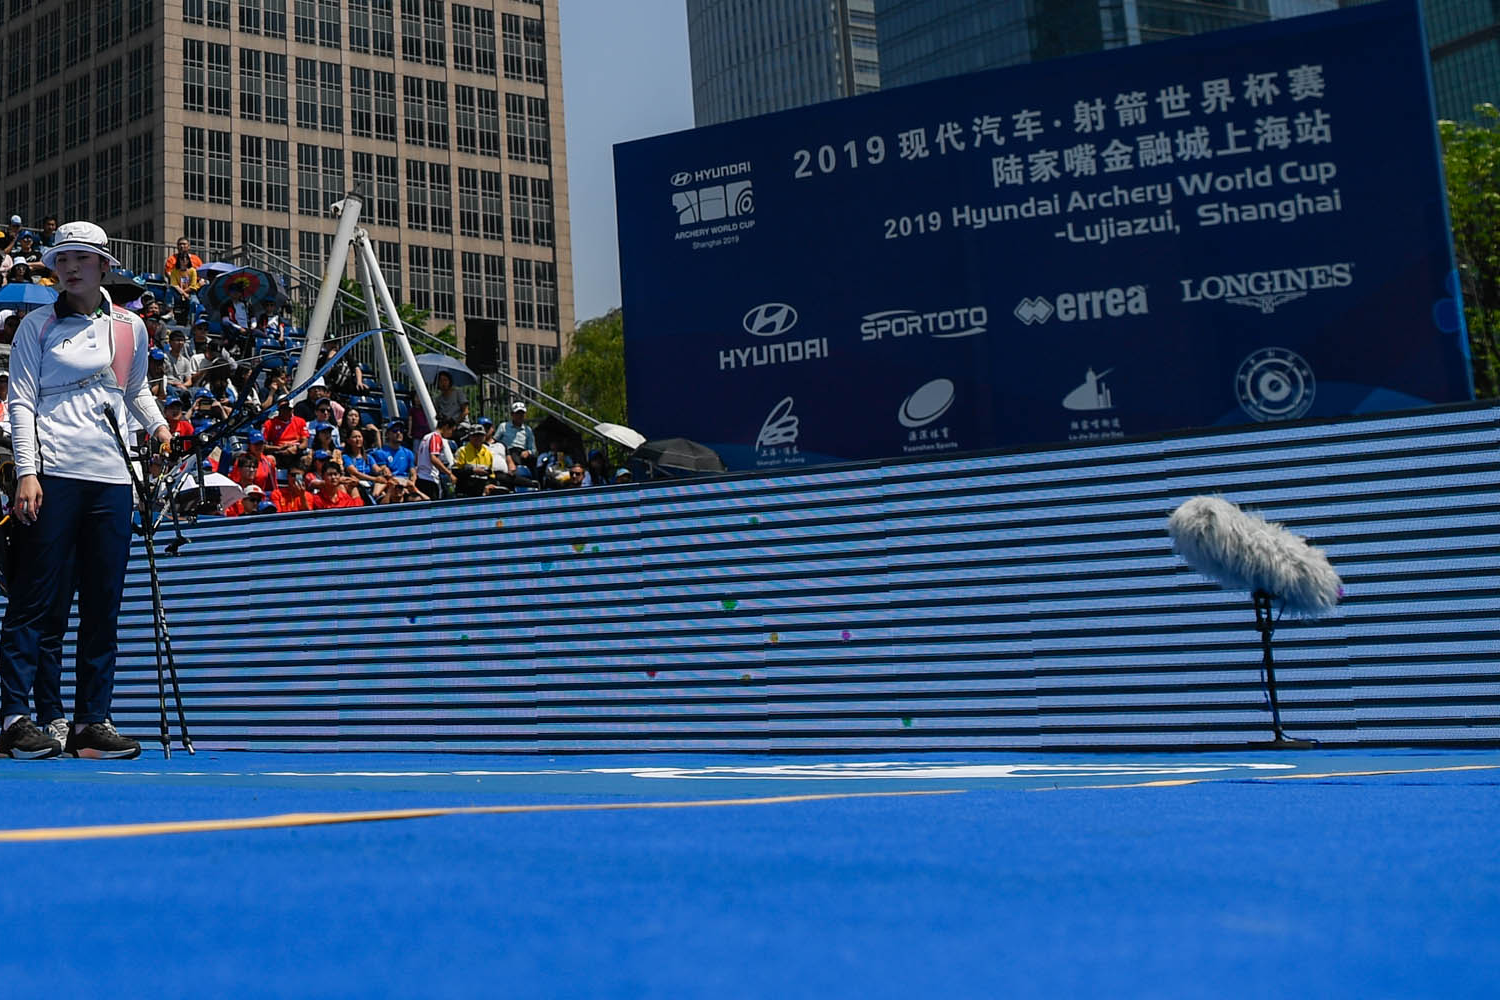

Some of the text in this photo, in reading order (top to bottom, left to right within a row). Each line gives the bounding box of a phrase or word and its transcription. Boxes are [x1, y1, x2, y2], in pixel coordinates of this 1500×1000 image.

[992, 109, 1333, 188] 陆家嘴金融城上海站
[694, 161, 752, 182] HYUNDAI
[884, 161, 1338, 239] 2019 Hyundai Archery World Cup
[1197, 189, 1342, 227] Shanghai
[674, 220, 756, 240] ARCHERY WORLD CUP
[1180, 262, 1353, 302] LONGINES
[860, 306, 988, 341] SPORTOTO
[719, 337, 829, 370] HYUNDAI
